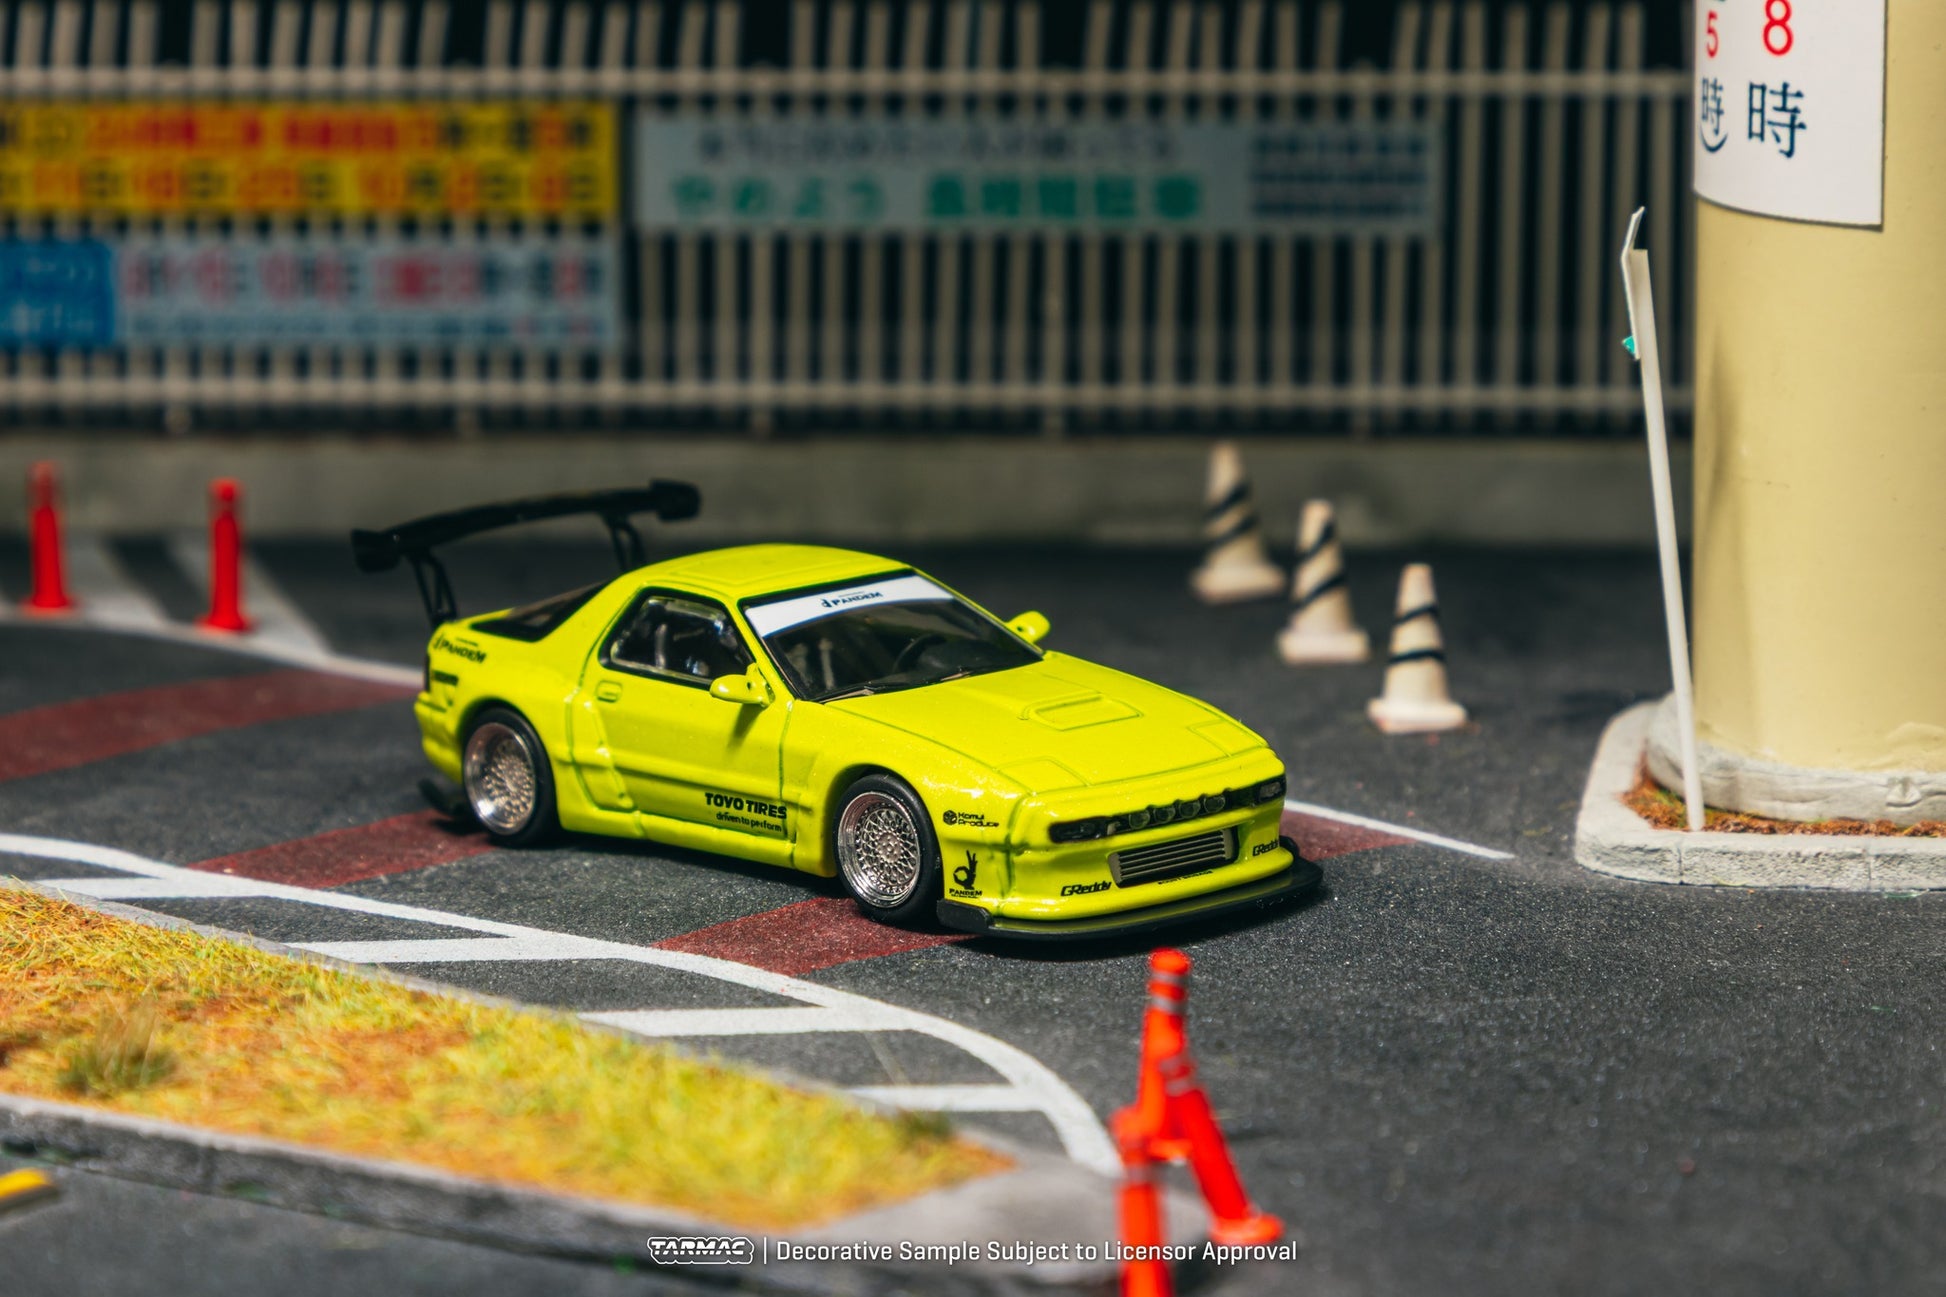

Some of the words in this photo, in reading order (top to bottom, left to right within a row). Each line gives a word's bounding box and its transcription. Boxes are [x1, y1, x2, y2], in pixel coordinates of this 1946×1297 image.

[705, 792, 744, 811] TOYO
[745, 800, 787, 819] TIRES
[1060, 880, 1112, 897] GReddy
